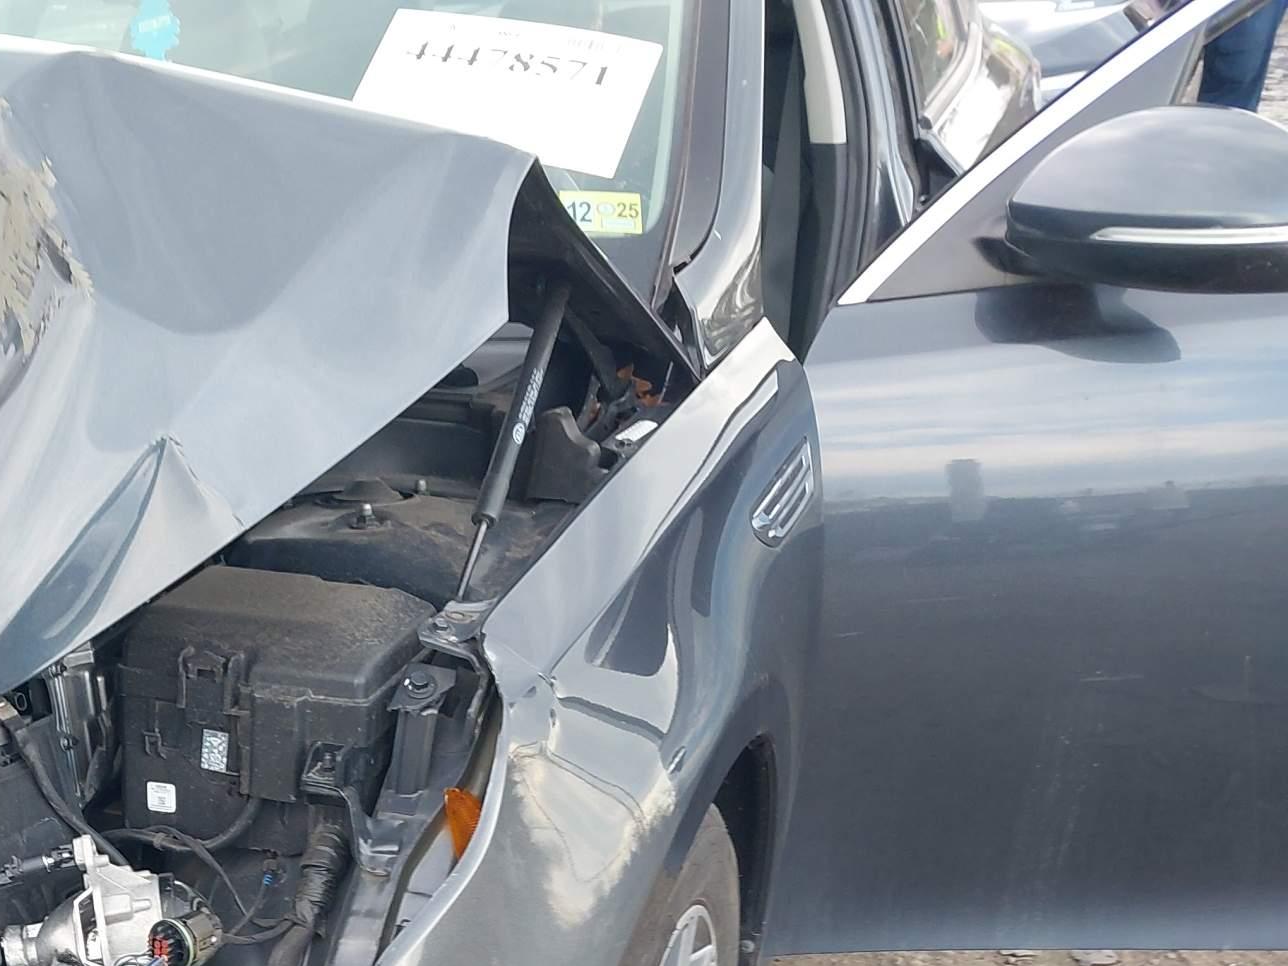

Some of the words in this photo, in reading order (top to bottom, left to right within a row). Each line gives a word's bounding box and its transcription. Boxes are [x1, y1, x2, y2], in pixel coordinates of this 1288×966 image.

[404, 41, 608, 86] 44478571
[566, 200, 593, 223] 12
[616, 202, 640, 219] 25
